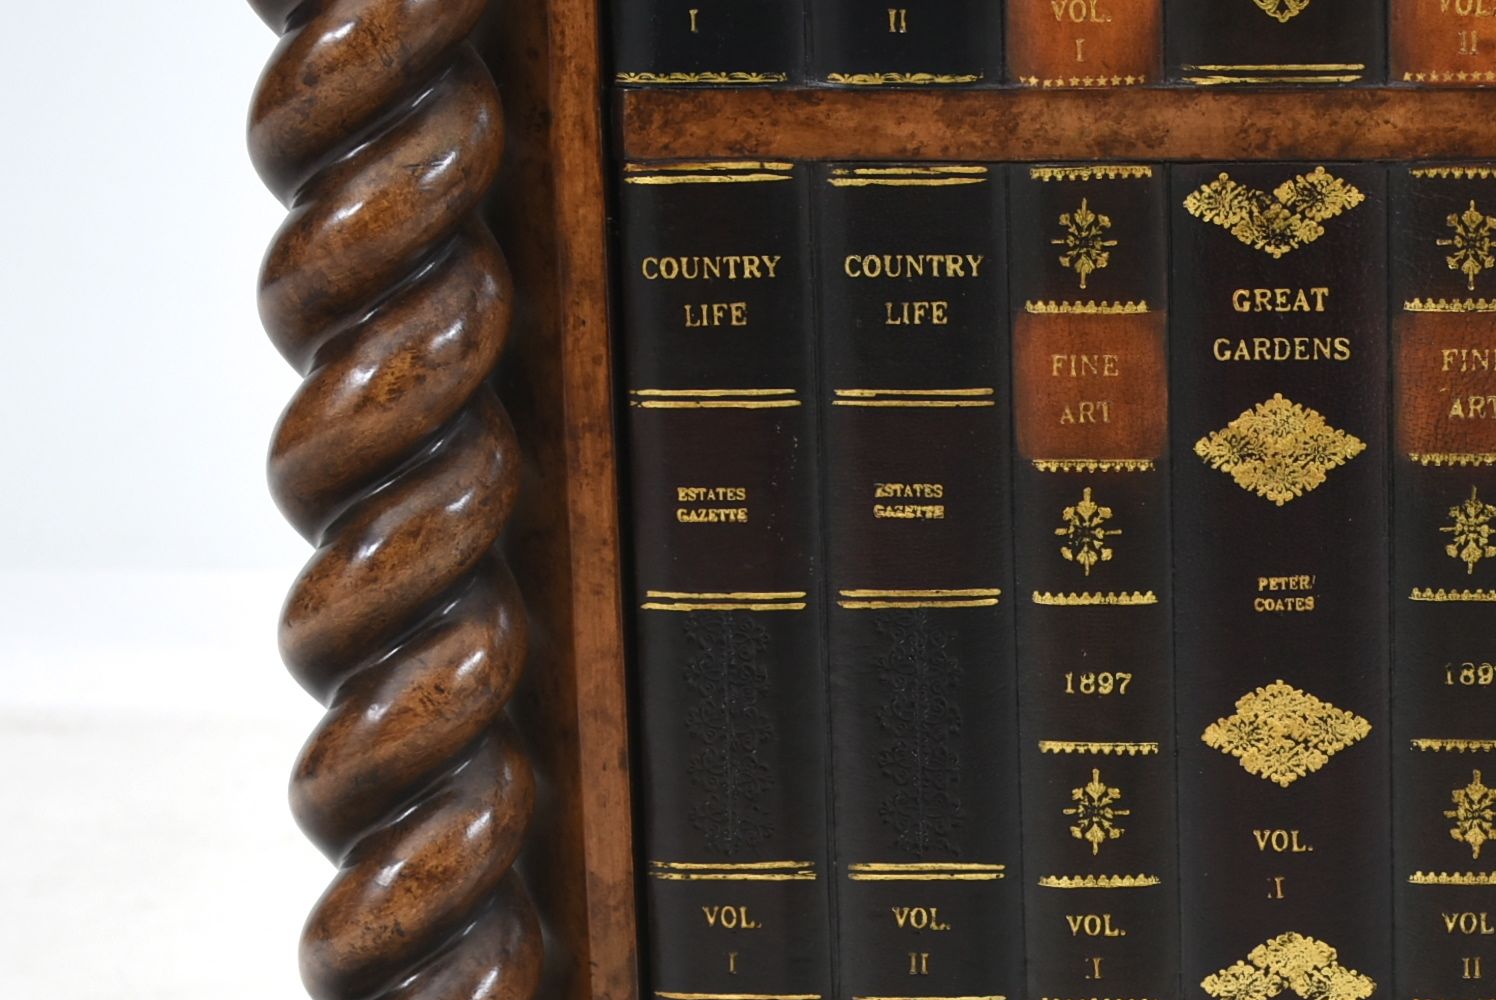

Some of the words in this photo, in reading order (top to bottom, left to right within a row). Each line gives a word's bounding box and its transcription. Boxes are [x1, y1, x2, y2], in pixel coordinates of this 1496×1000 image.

[689, 9, 698, 32] I
[888, 9, 908, 32] II
[1075, 39, 1085, 62] I
[1459, 31, 1478, 55] II
[642, 256, 782, 279] COUNTRY
[844, 255, 984, 278] COUNTRY
[1232, 288, 1329, 312] GREAT
[684, 302, 748, 327] LIFE
[886, 302, 948, 324] LIFE
[1213, 338, 1352, 361] GARDENS
[1051, 355, 1119, 377] FINE
[1059, 402, 1112, 425] ART
[677, 487, 746, 502] ESTATES
[874, 483, 943, 499] ESTATES
[677, 508, 748, 522] GAZETTE
[873, 504, 944, 519] GAZETTE
[1257, 576, 1311, 592] PETER
[1254, 596, 1314, 612] COATES
[1064, 673, 1132, 694] 1897
[1254, 829, 1314, 852] VOL.
[1273, 877, 1284, 899] I
[703, 906, 762, 928] VOL.
[892, 907, 951, 931] VOL.
[1066, 914, 1126, 937] VOL.
[728, 952, 737, 974] I
[908, 953, 929, 975] II
[1090, 957, 1103, 980] I
[1462, 957, 1481, 979] II
